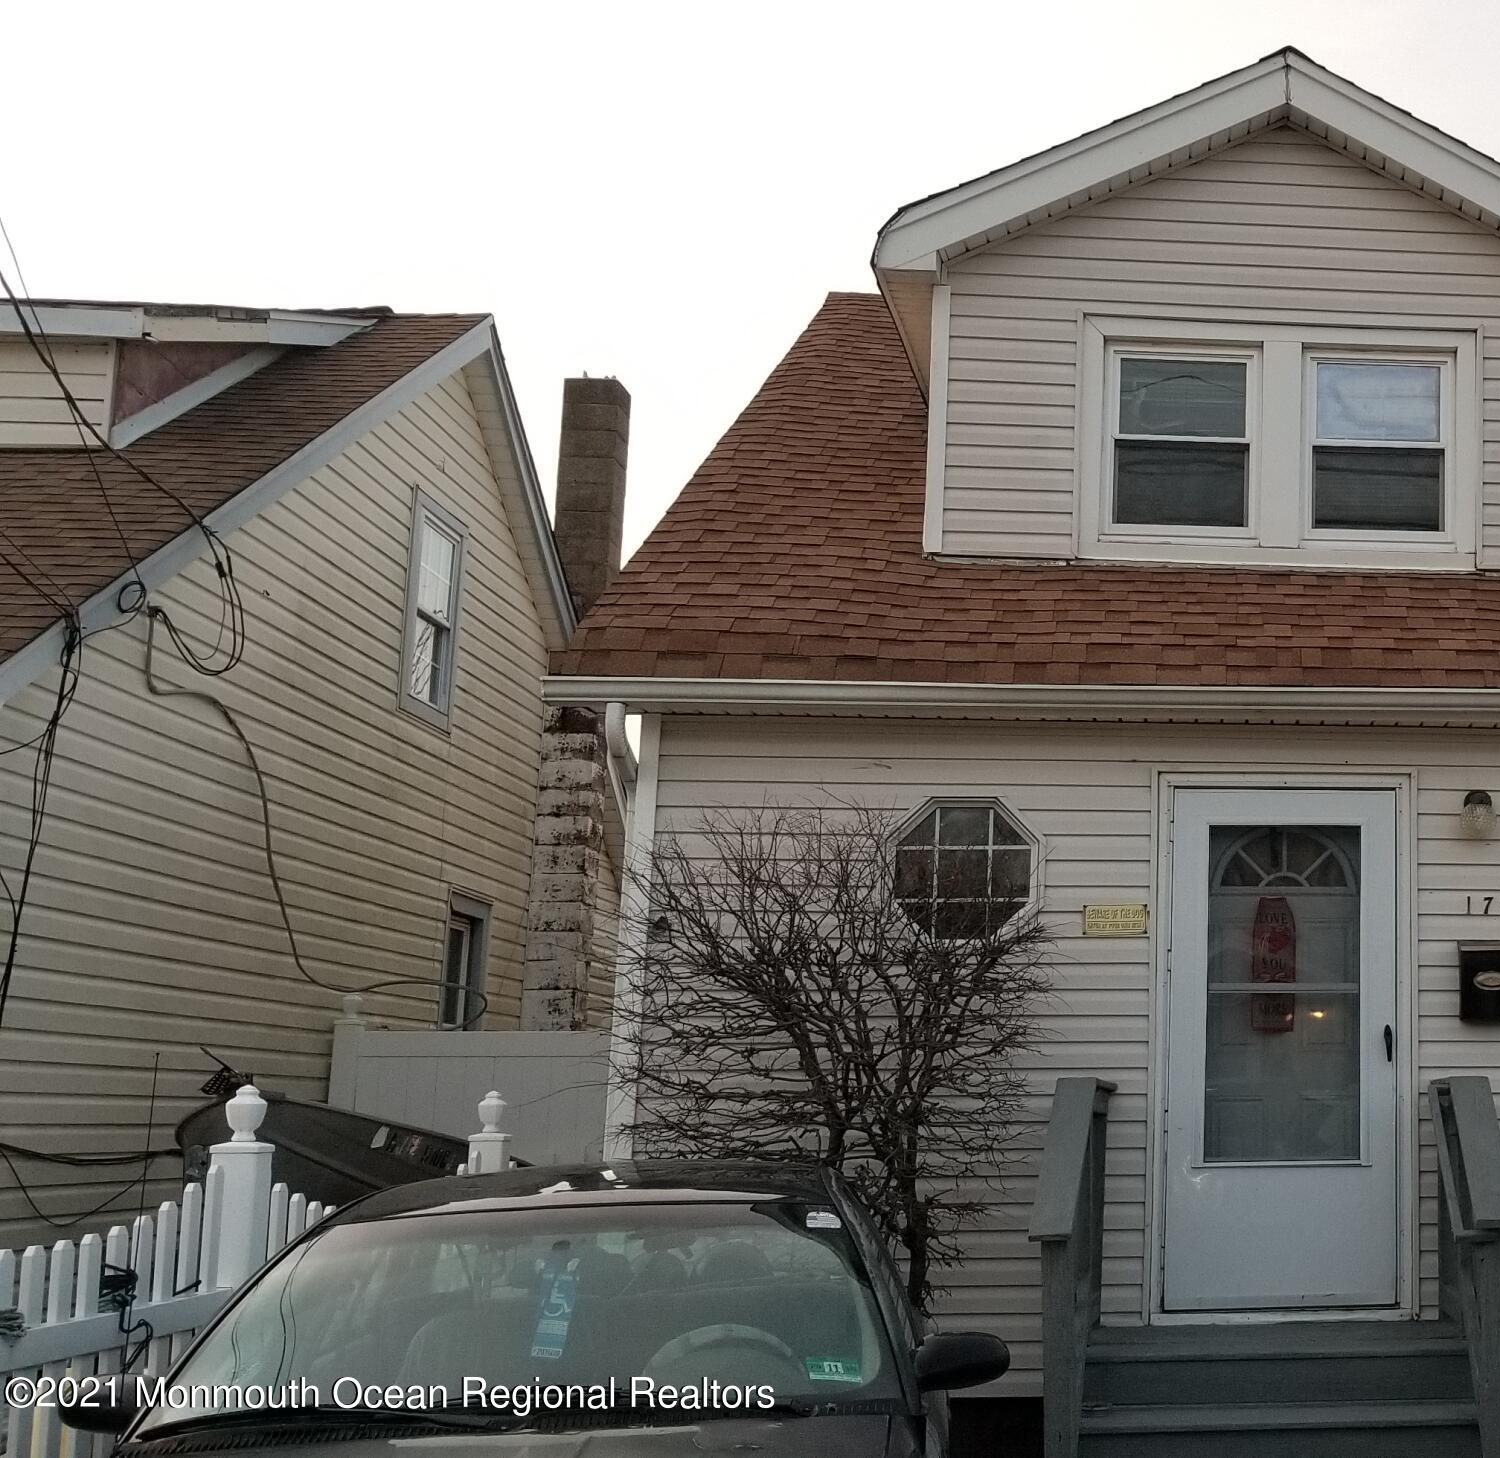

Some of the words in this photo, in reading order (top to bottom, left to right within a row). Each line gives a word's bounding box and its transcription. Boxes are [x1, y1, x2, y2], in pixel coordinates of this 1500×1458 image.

[1087, 908, 1110, 919] BEWARE
[1111, 908, 1119, 919] OF
[1120, 908, 1131, 919] THE
[1131, 908, 1143, 919] DOG
[1258, 912, 1288, 925] LOVE
[1261, 958, 1287, 970] YOU
